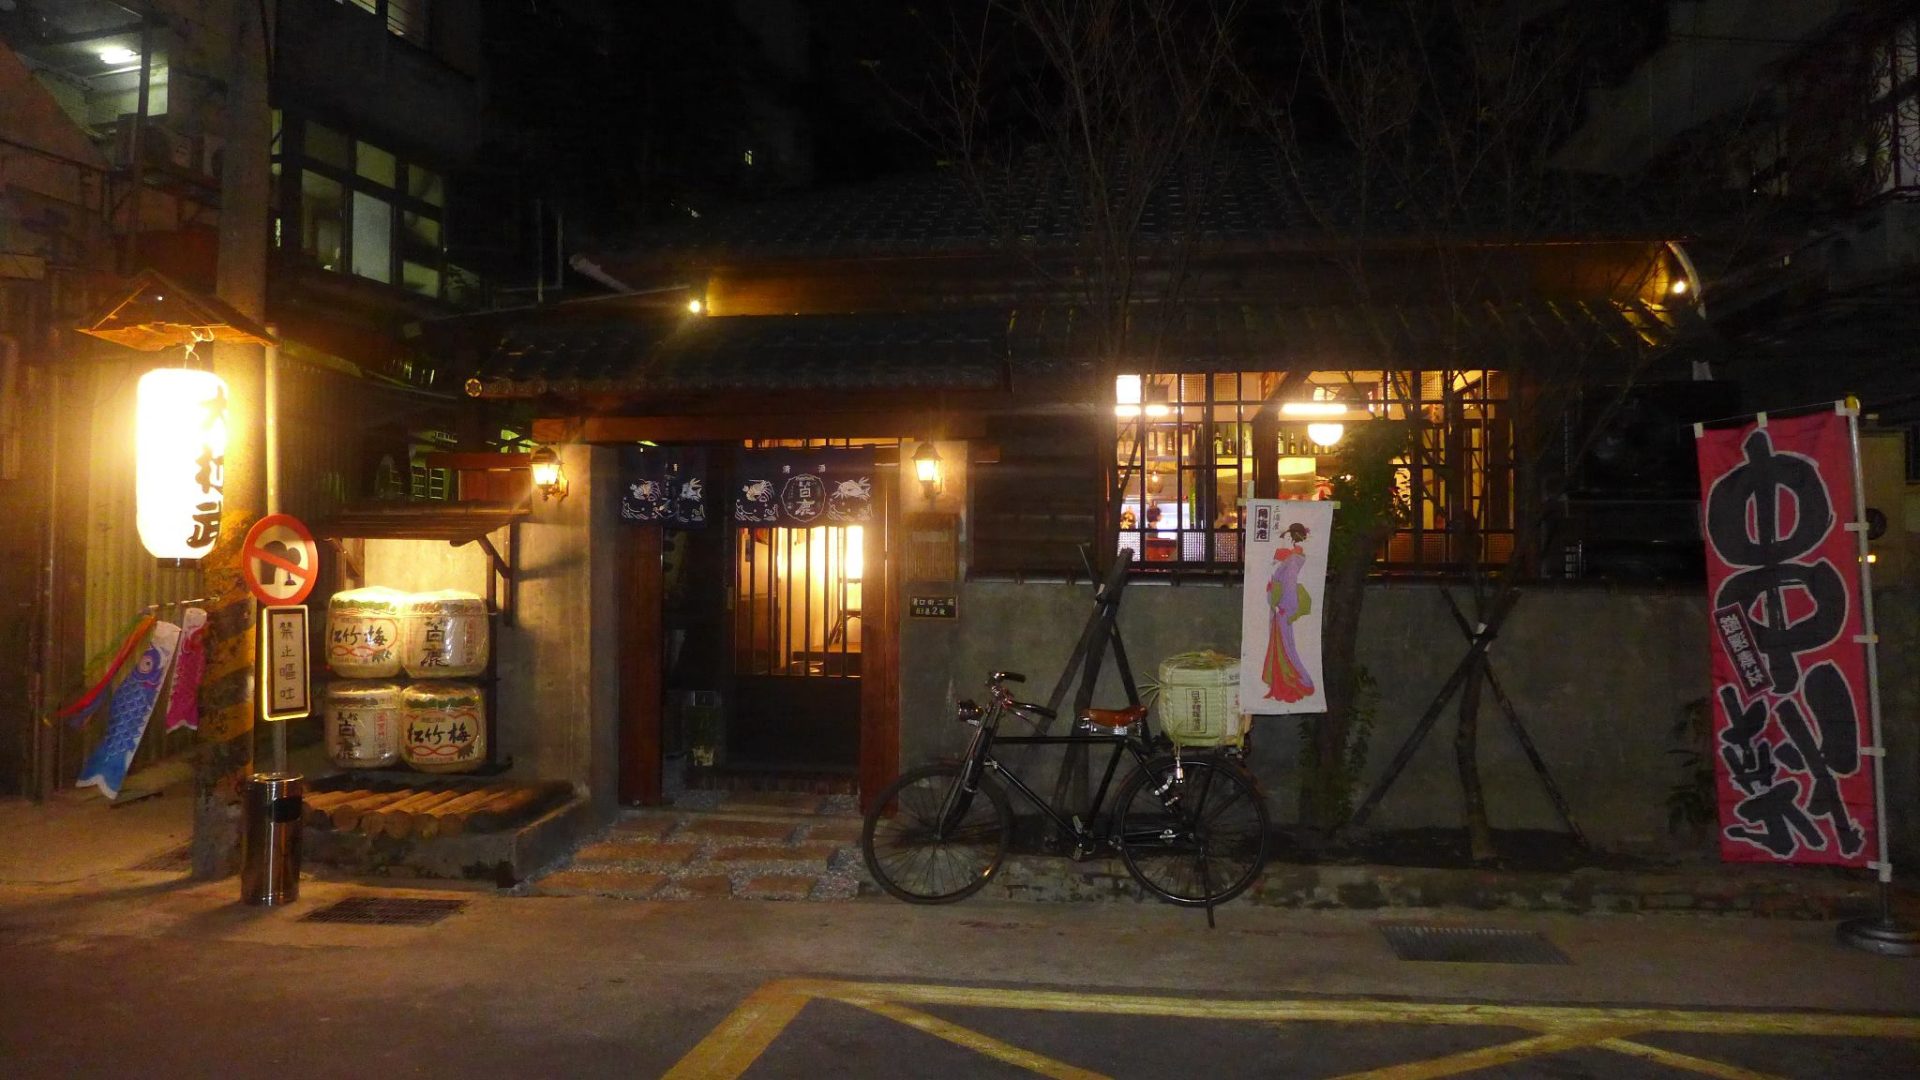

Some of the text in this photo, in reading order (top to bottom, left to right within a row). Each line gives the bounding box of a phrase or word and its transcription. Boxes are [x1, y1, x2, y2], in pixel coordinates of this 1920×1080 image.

[279, 620, 296, 700] 禁止嘔吐
[407, 721, 472, 745] 松竹梅
